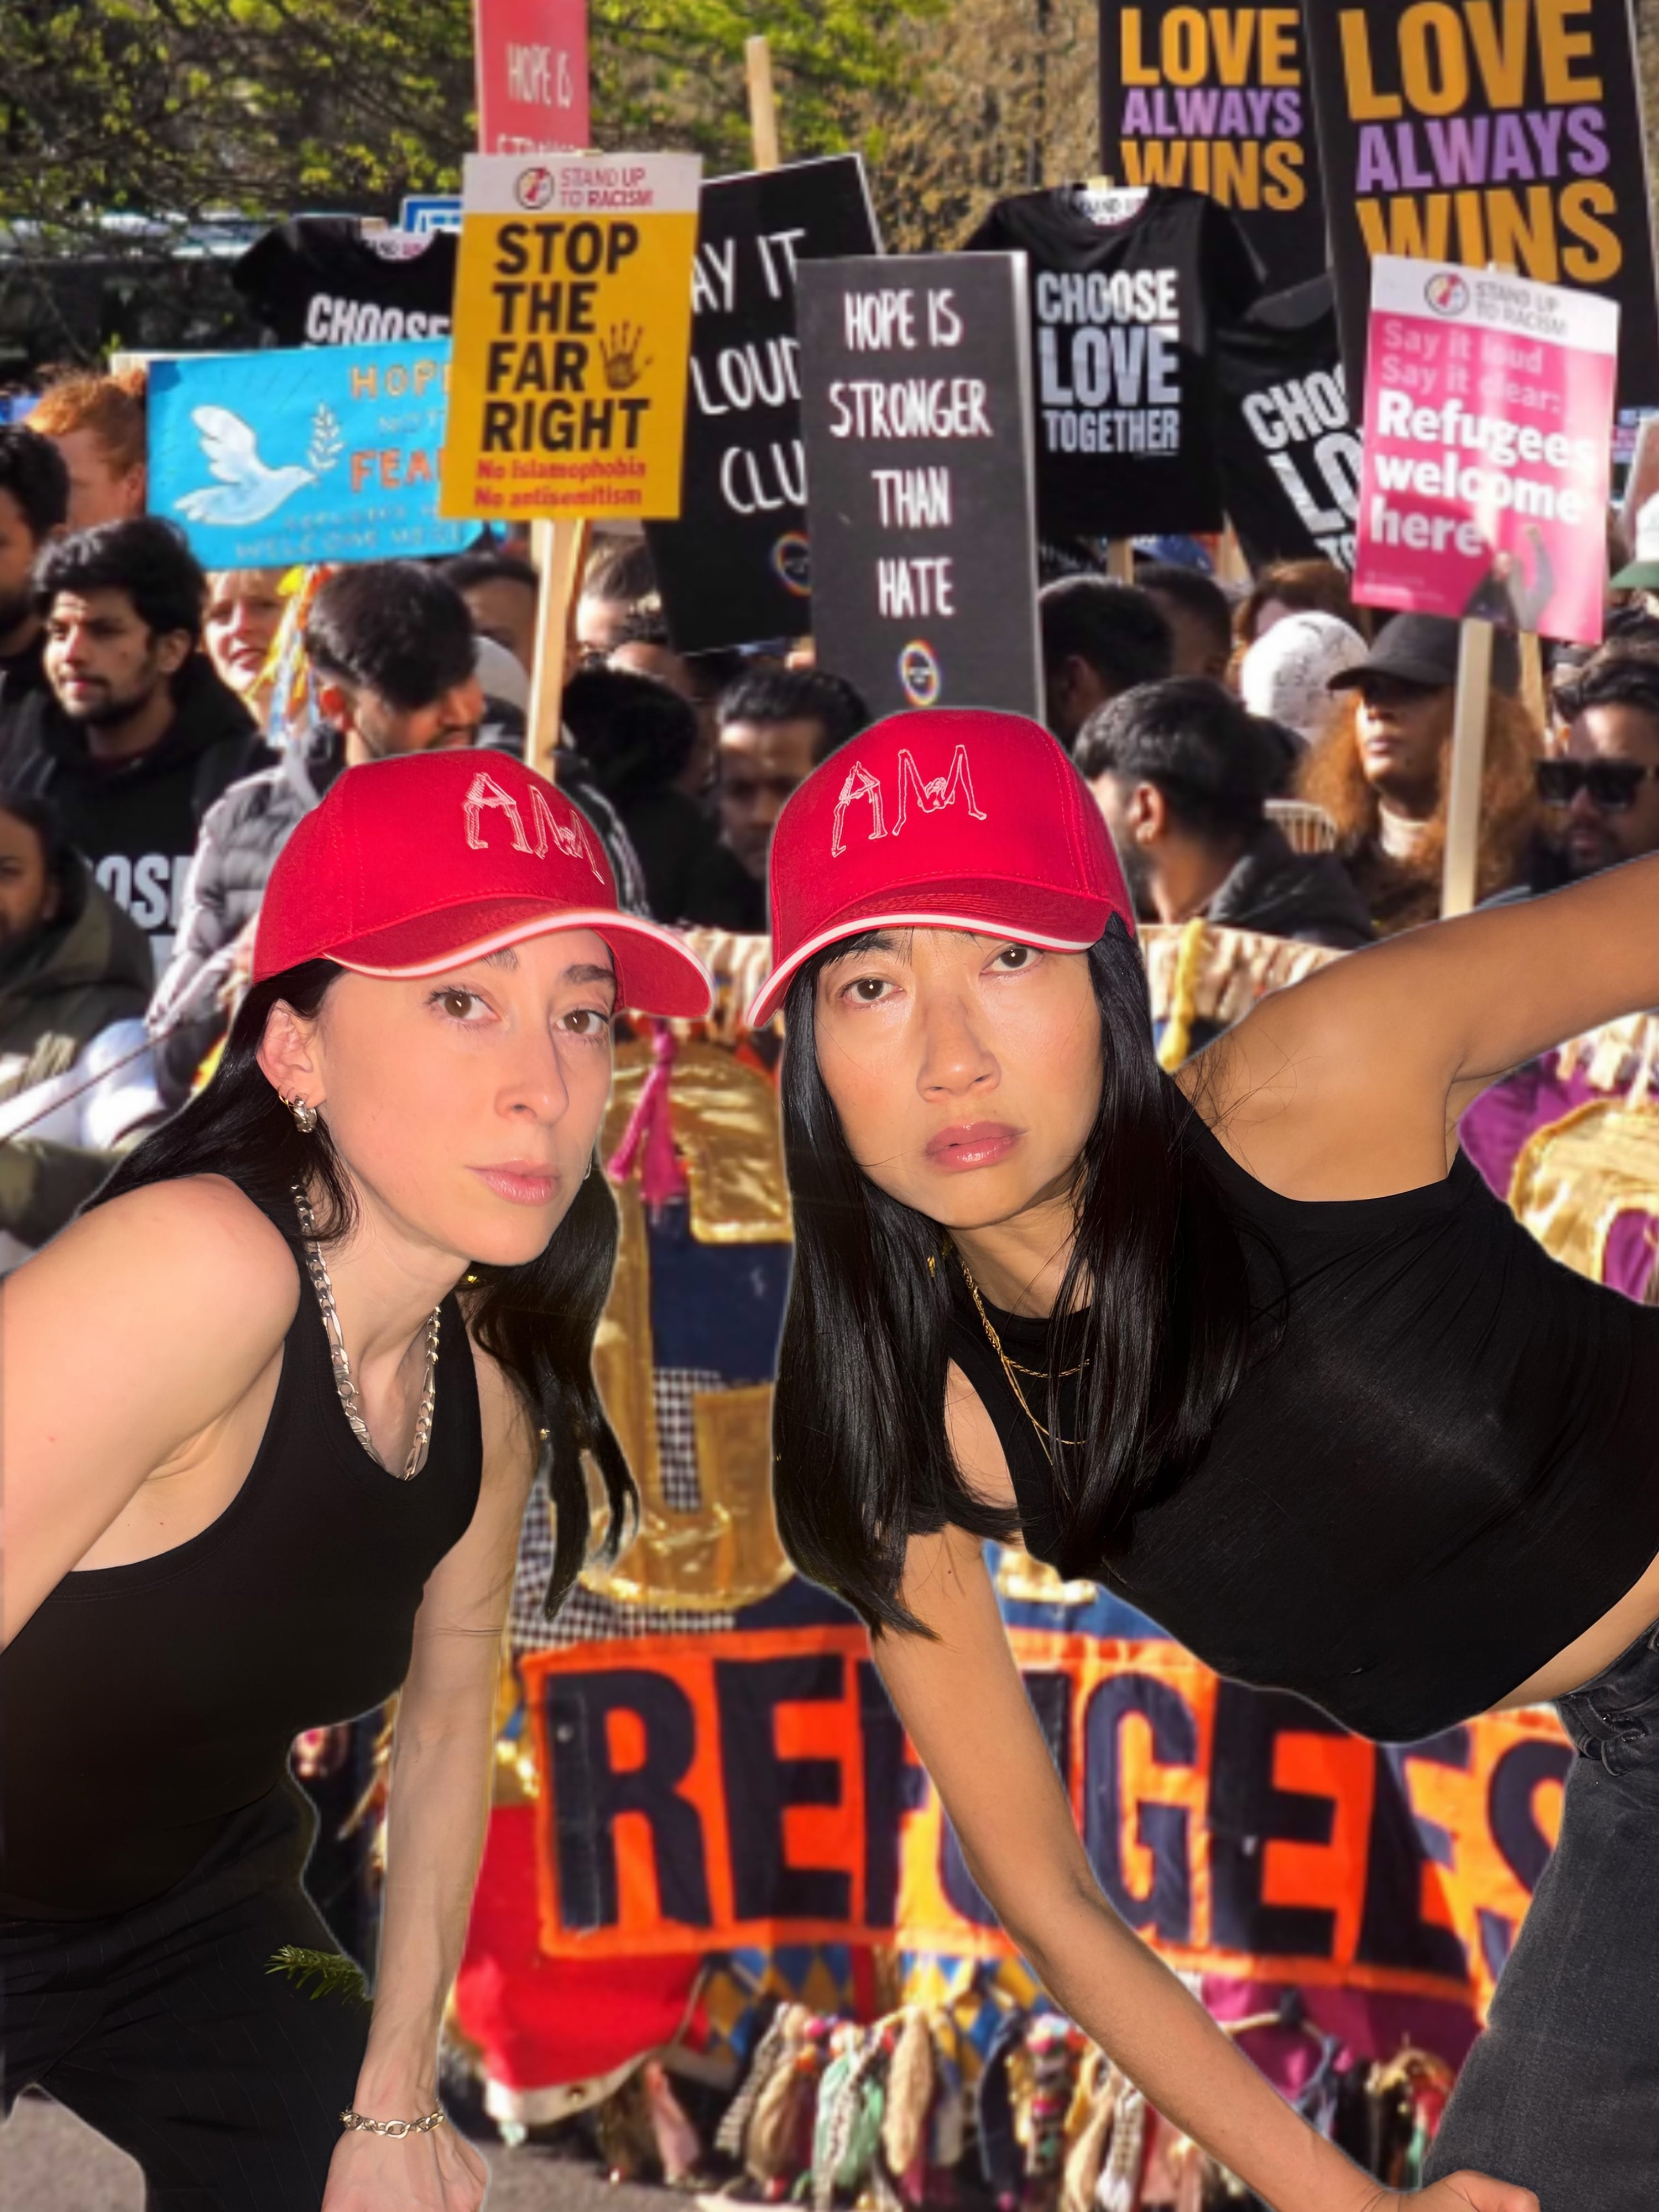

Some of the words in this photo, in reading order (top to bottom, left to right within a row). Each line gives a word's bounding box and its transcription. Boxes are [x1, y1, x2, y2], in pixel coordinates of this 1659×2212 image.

[1120, 6, 1301, 86] LOVE
[1339, 0, 1603, 120] LOVE
[507, 43, 552, 106] HOPE
[1120, 88, 1302, 137] ALWAYS
[1119, 140, 1306, 210] WINS
[1355, 107, 1610, 192] ALWAYS
[561, 168, 618, 187] STAND
[622, 168, 646, 185] UP
[561, 190, 585, 206] TO
[588, 190, 653, 206] RACISM
[494, 221, 639, 275] STOP
[1355, 180, 1623, 284] WINS
[757, 228, 806, 299] IT
[492, 282, 597, 334] THE
[844, 288, 916, 352] HOPE
[928, 288, 962, 348] IS
[1036, 269, 1179, 324] CHOOSE
[1476, 281, 1531, 309] STAND
[1503, 306, 1567, 336] RACISM
[486, 340, 589, 393] FAR
[1038, 326, 1180, 407] LOVE
[1385, 320, 1441, 361] Say
[1448, 325, 1471, 359] it
[351, 359, 451, 399] HOP
[1382, 354, 1437, 396] Say
[1447, 361, 1470, 394] it
[481, 398, 650, 452] RIGHT
[829, 378, 994, 439] STRONGER
[1042, 409, 1180, 454] TOGETHER
[1242, 363, 1349, 449] CHO
[1378, 388, 1598, 470] Refugees
[351, 447, 447, 493] FEA
[474, 486, 504, 507] No
[510, 486, 642, 506] antisemitism
[477, 460, 506, 480] No
[512, 457, 646, 482] Islamophobia
[1374, 451, 1587, 525] welcome
[871, 466, 952, 529] THAN
[1370, 495, 1484, 556] here
[877, 556, 956, 618] HATE
